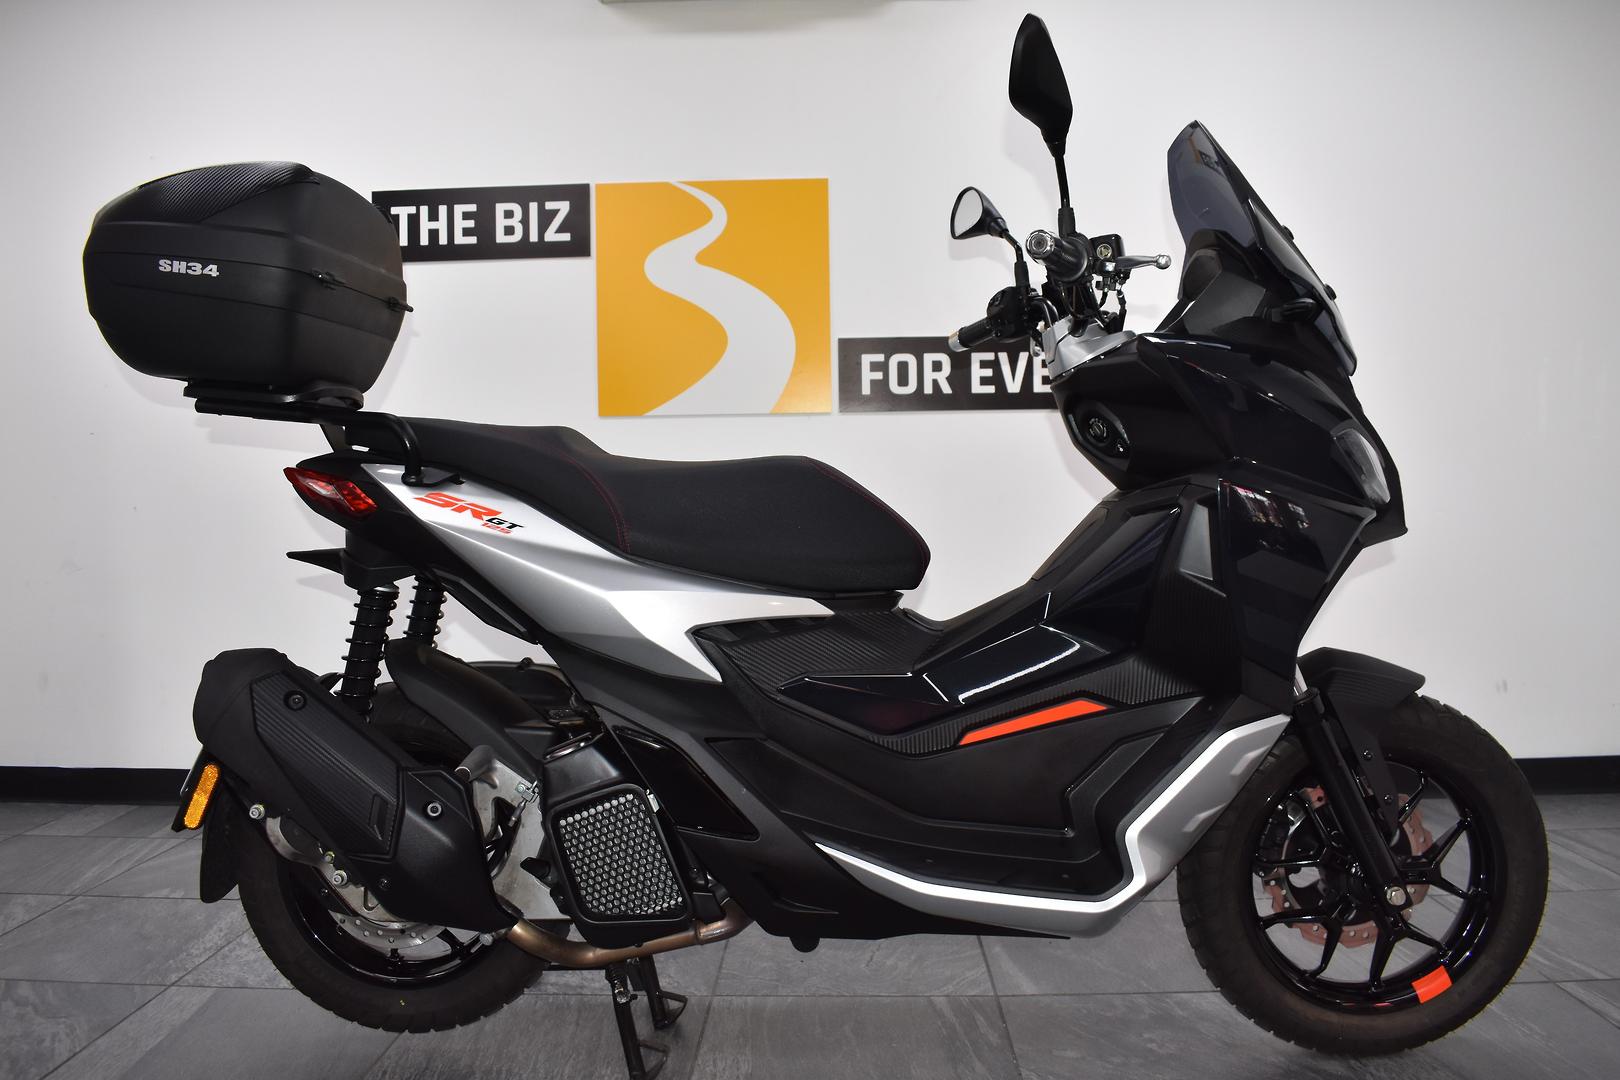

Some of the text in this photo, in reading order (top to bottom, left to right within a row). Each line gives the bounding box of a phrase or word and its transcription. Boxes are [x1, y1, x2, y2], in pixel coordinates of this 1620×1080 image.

[390, 200, 571, 247] THE BIZ
[158, 258, 220, 278] SH34
[861, 351, 1053, 395] FOR EVE
